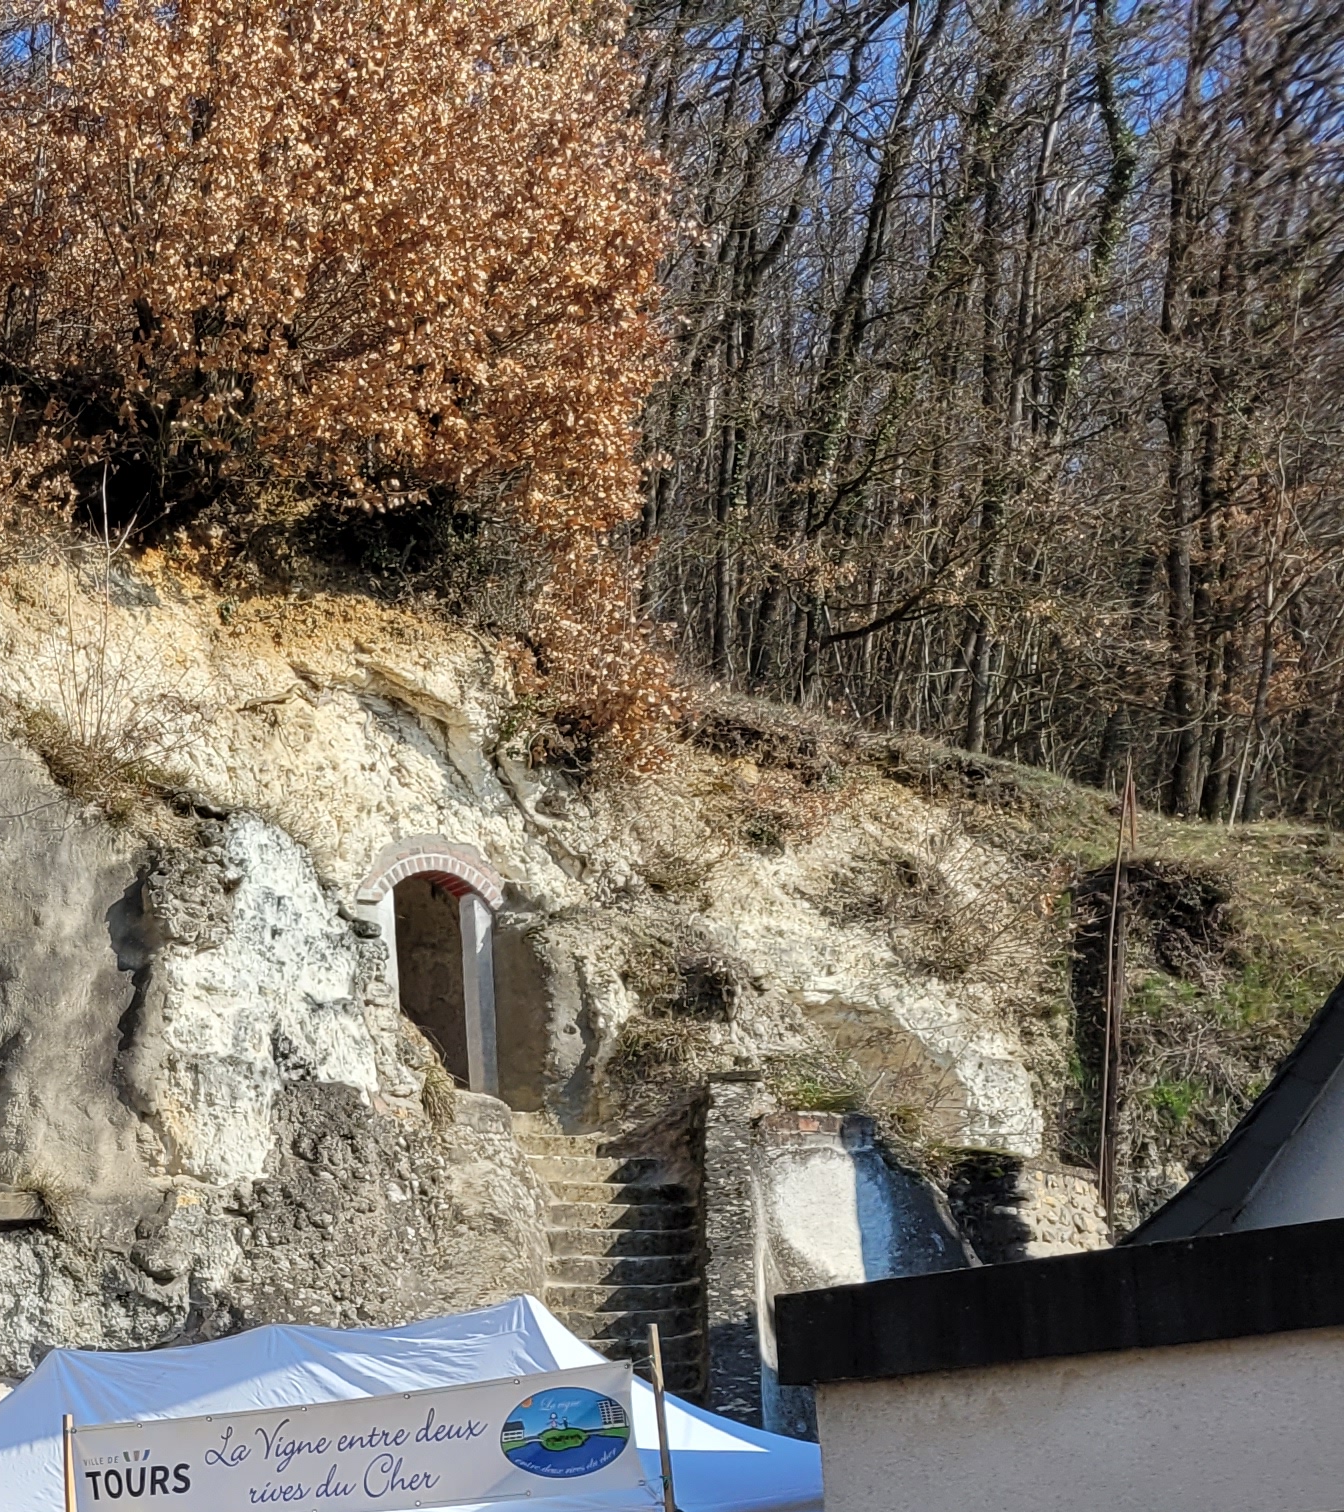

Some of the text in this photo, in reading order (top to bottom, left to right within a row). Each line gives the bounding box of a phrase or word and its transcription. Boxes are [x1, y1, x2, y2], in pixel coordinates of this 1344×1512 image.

[83, 1455, 119, 1466] VILLE DE
[205, 1408, 488, 1473] La Vigne entre deux
[85, 1463, 191, 1500] TOURS
[249, 1453, 441, 1504] rives du Cher
